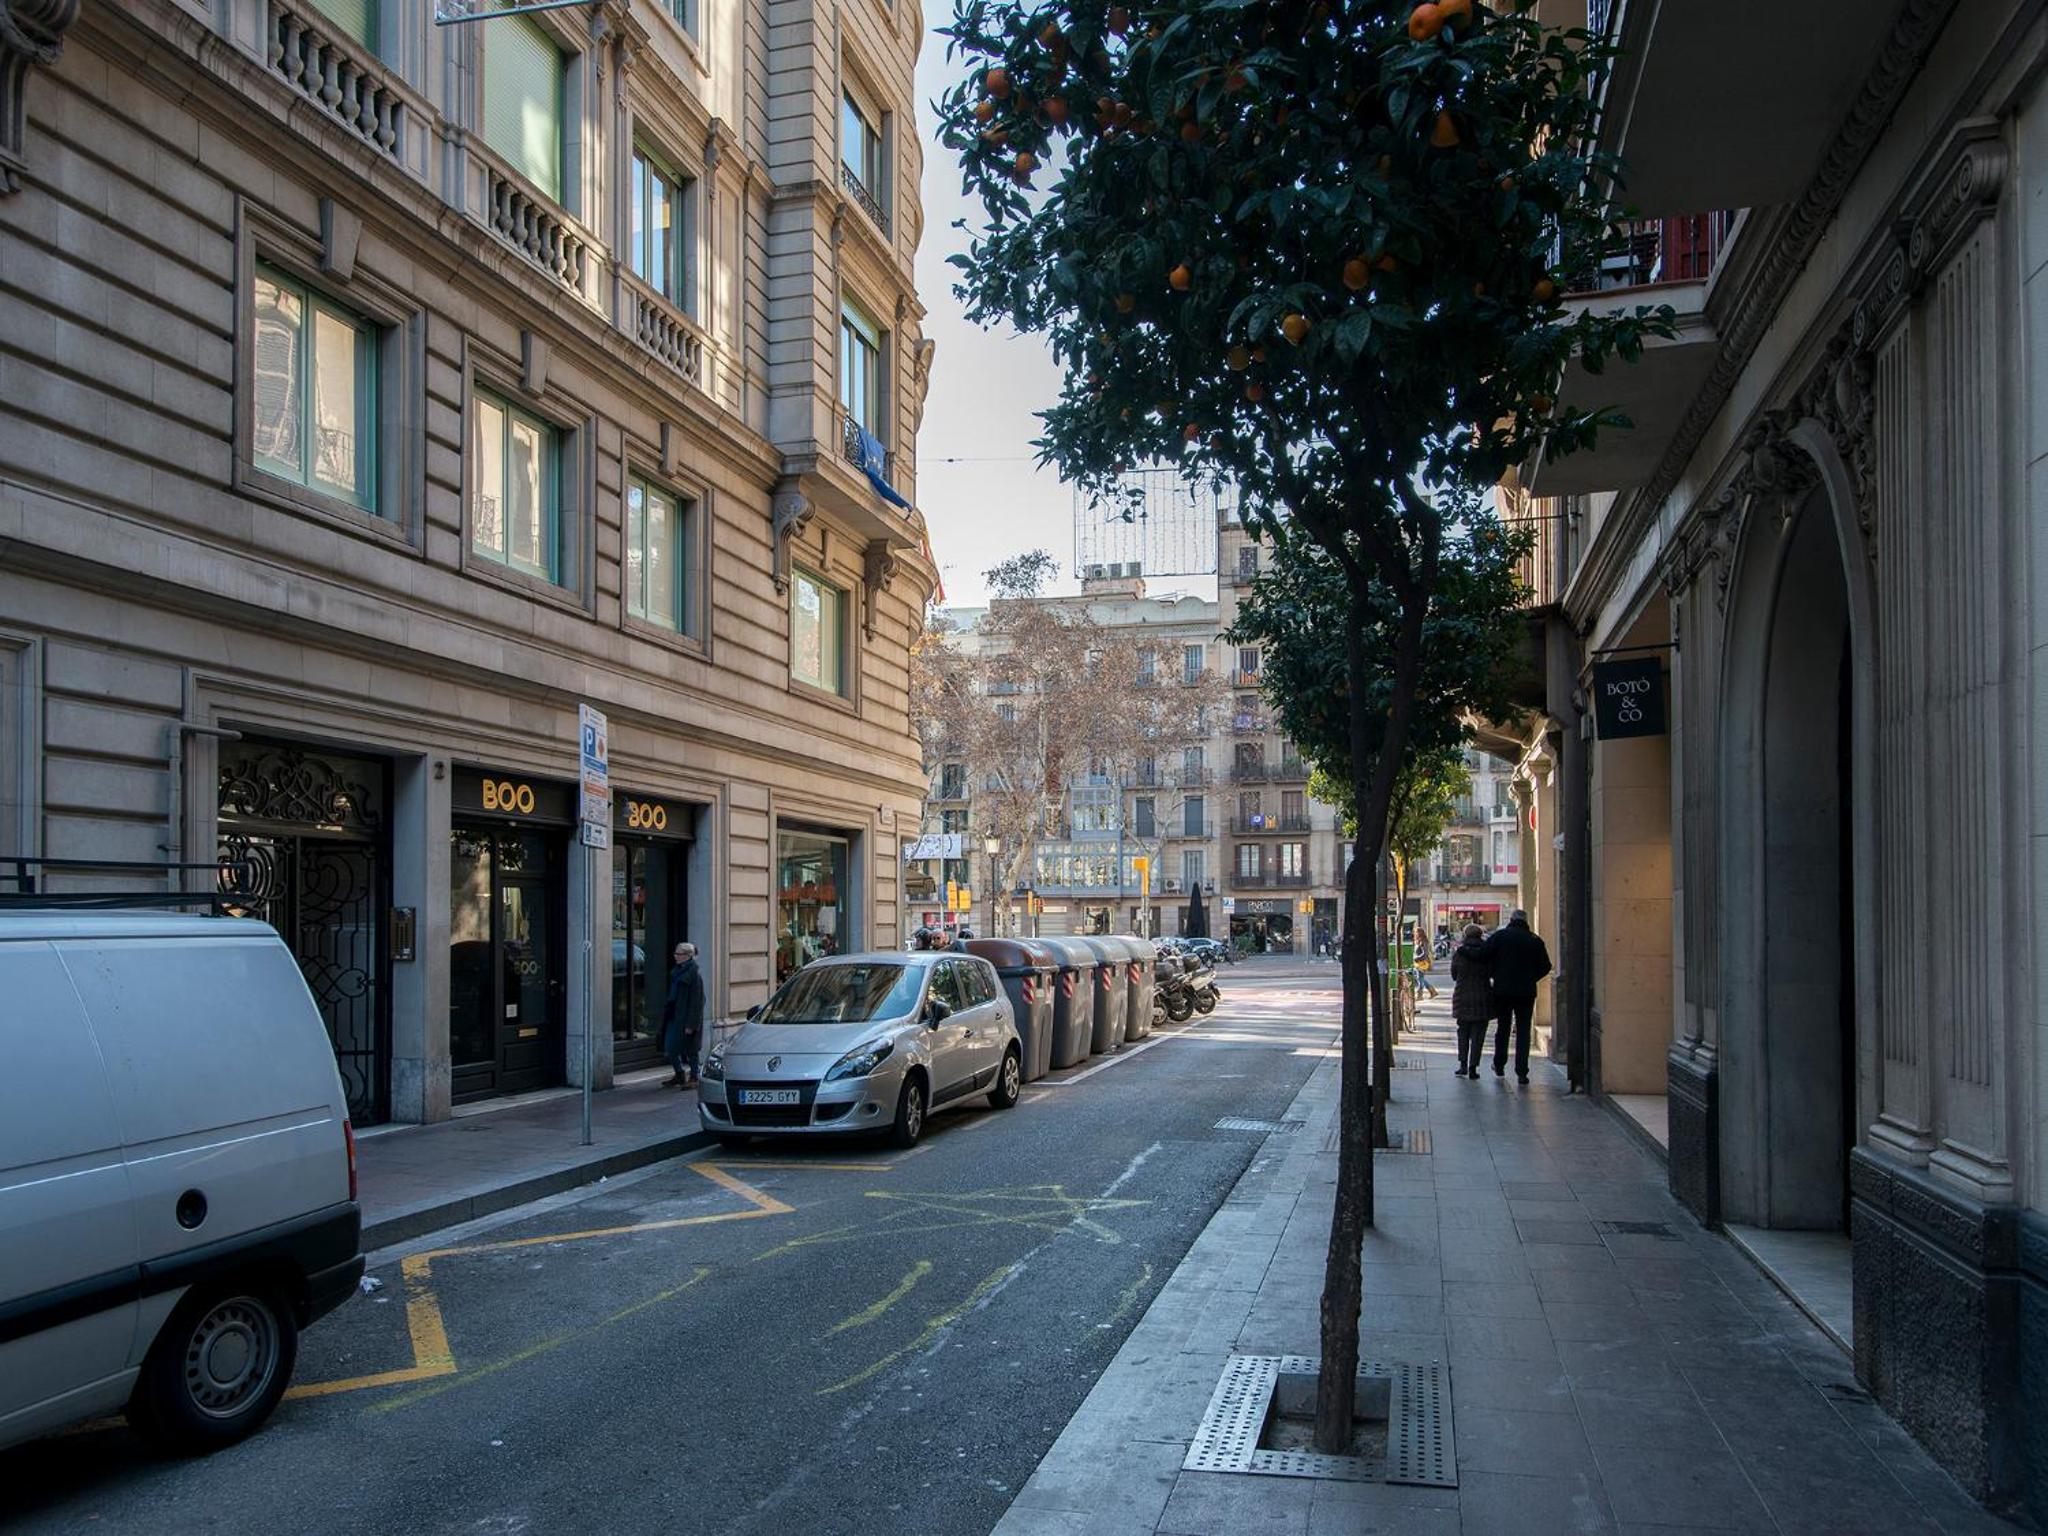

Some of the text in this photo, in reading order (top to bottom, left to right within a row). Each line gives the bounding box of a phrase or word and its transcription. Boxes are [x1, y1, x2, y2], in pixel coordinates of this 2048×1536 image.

[1621, 696, 1637, 708] &
[1618, 709, 1643, 722] CO
[586, 728, 594, 753] P
[483, 779, 535, 814] BOO
[626, 801, 667, 830] BOO
[747, 1091, 797, 1103] 3225 GYY
